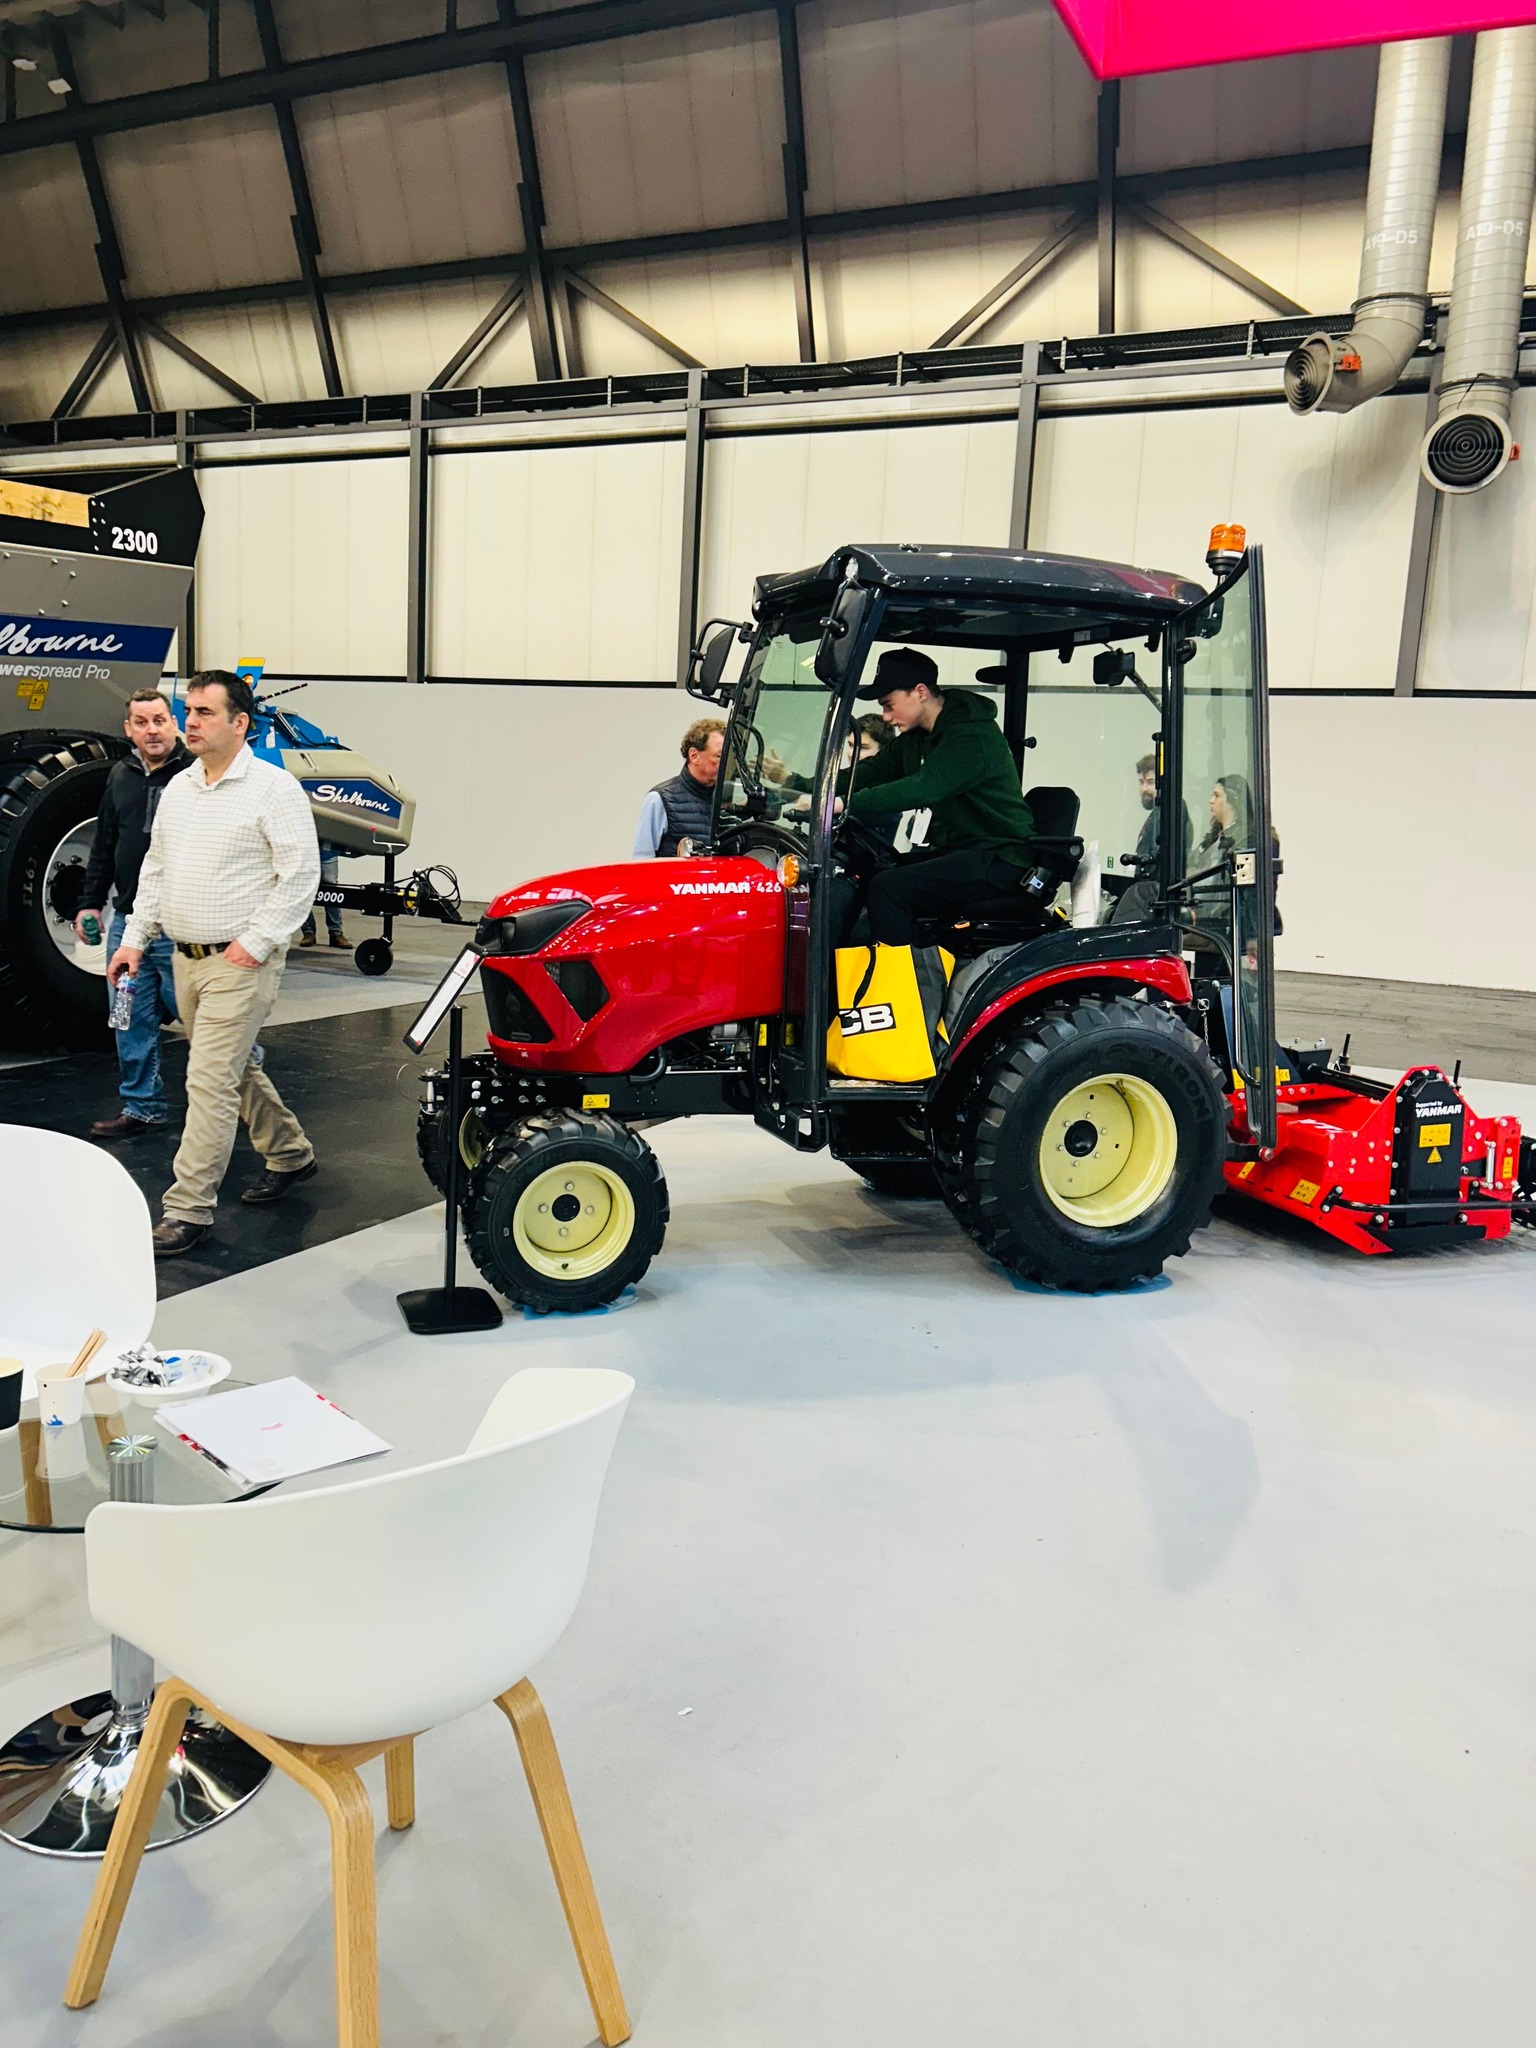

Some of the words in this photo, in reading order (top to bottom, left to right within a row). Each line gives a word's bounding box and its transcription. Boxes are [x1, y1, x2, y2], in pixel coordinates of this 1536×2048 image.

[112, 527, 158, 554] 2300
[85, 664, 111, 680] Pro
[312, 785, 390, 812] Shelbourne
[669, 882, 750, 895] YANMAR
[314, 892, 344, 903] 9000
[1415, 1104, 1462, 1118] YANMAR
